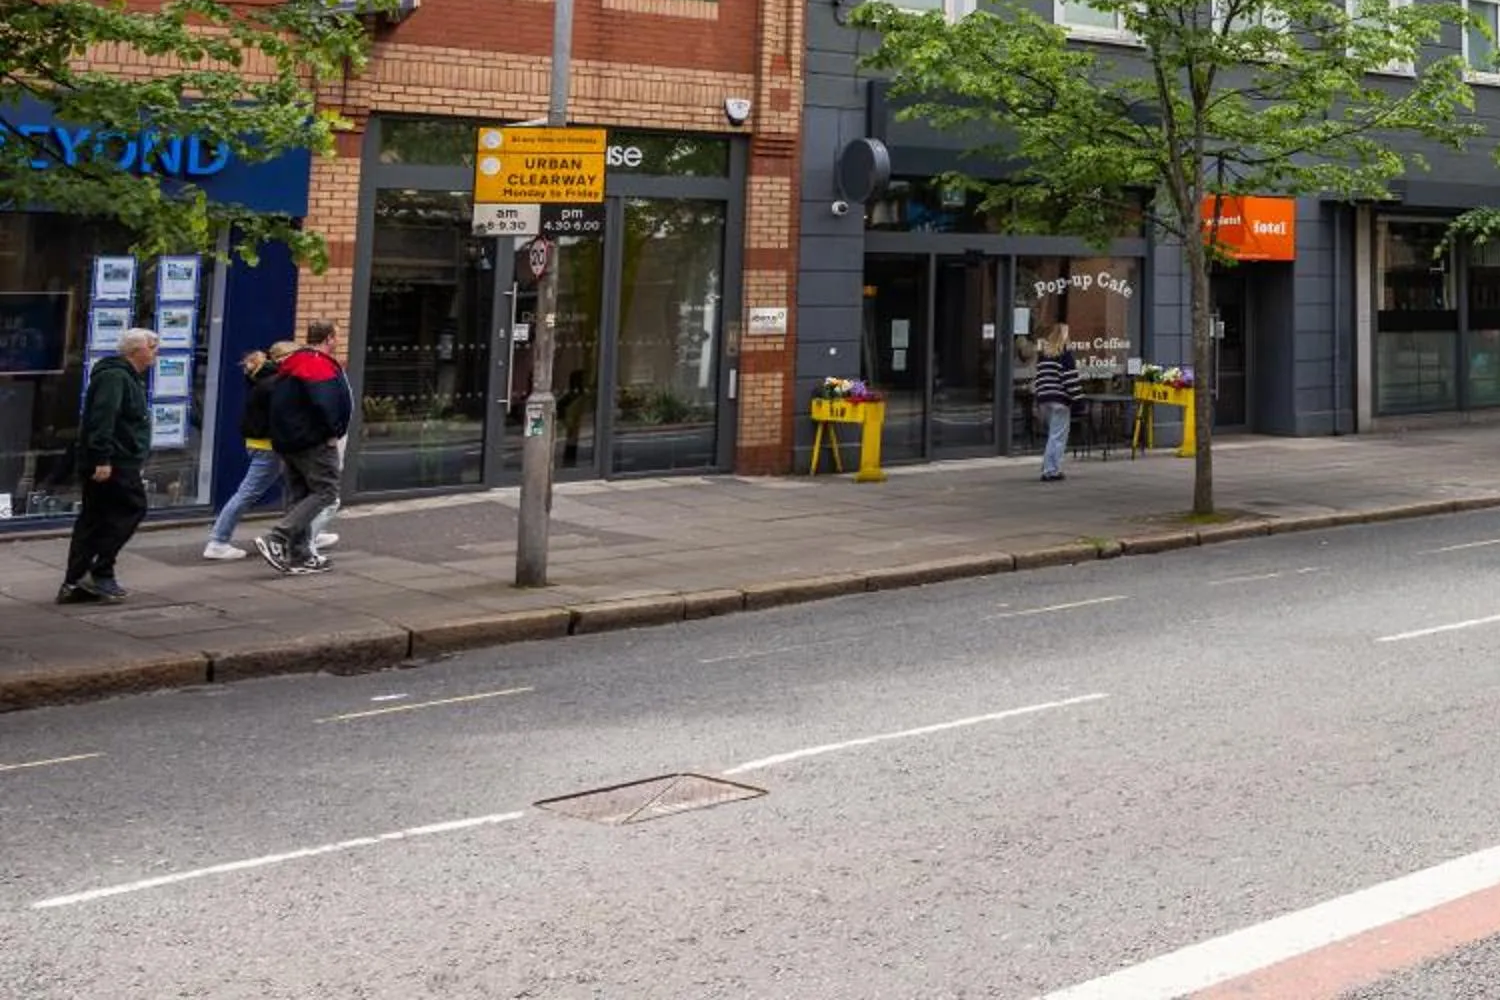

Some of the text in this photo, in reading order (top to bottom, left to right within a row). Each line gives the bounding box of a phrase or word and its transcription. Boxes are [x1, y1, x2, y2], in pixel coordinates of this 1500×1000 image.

[0, 122, 230, 176] EYOND
[525, 158, 583, 170] URBAN
[507, 174, 597, 186] CLEARWAY
[503, 189, 600, 200] Monday to Friday
[496, 208, 519, 219] am
[561, 208, 584, 221] pm
[530, 248, 545, 266] 20
[1034, 271, 1133, 299] Pop-up Cafe
